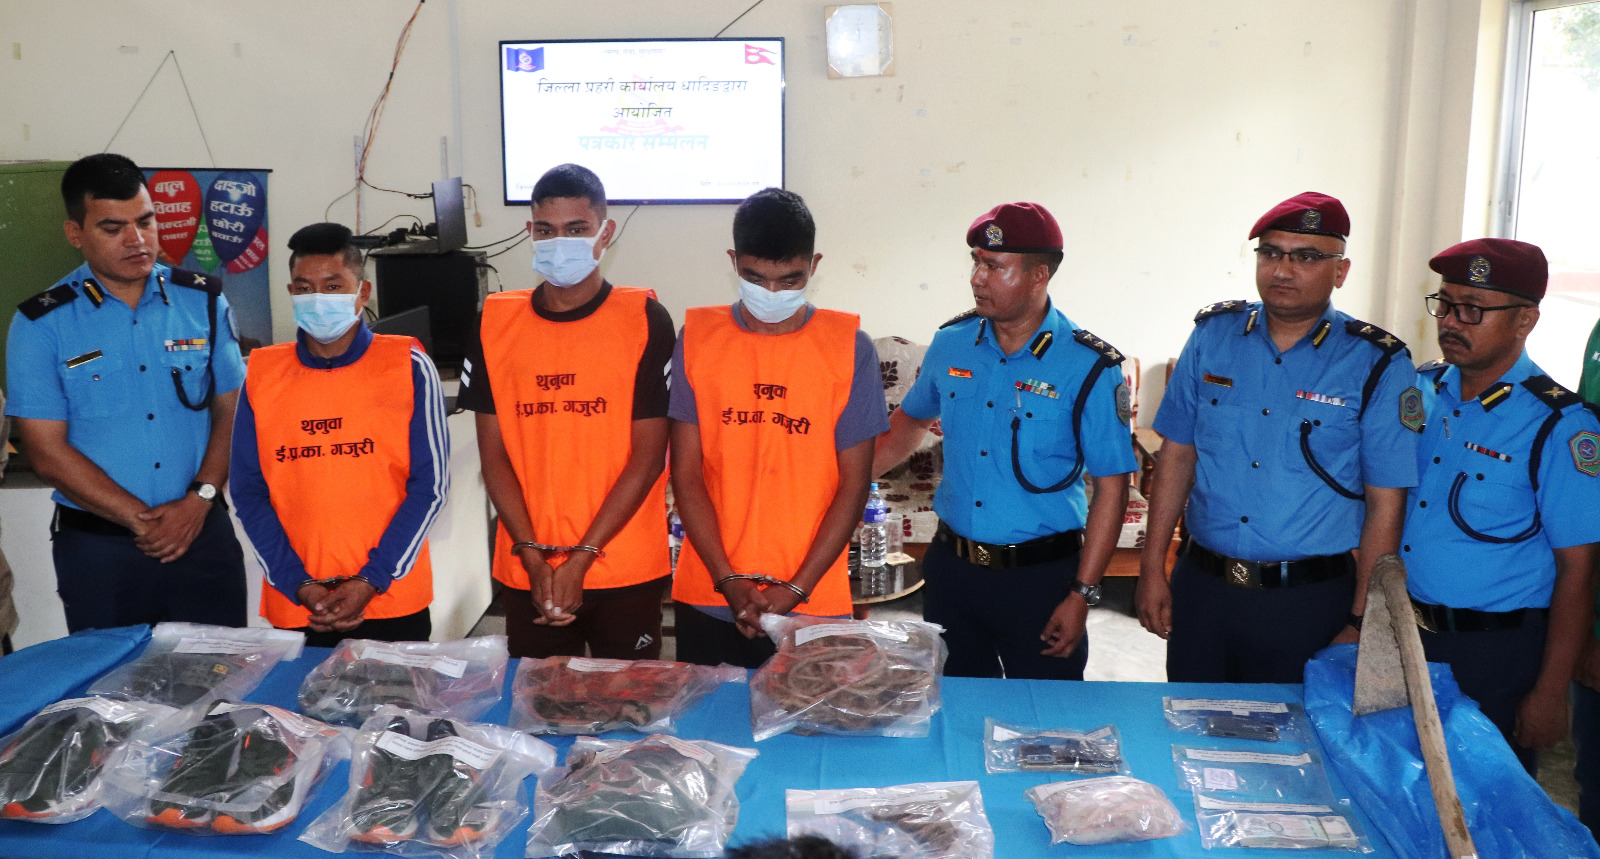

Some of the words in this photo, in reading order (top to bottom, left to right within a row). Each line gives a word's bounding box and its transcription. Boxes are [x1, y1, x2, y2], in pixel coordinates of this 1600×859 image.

[536, 78, 581, 94] जिल्ला
[584, 78, 615, 93] प्रहरी
[619, 76, 676, 93] कार्यालय
[613, 103, 673, 119] आयोजित
[577, 134, 637, 151] पत्रकार
[536, 373, 577, 391] थुनुवा
[563, 396, 607, 417] गजुरी
[301, 417, 343, 436] थुनुवा
[771, 411, 811, 435] गजुरी
[330, 437, 375, 458] गजुरी
